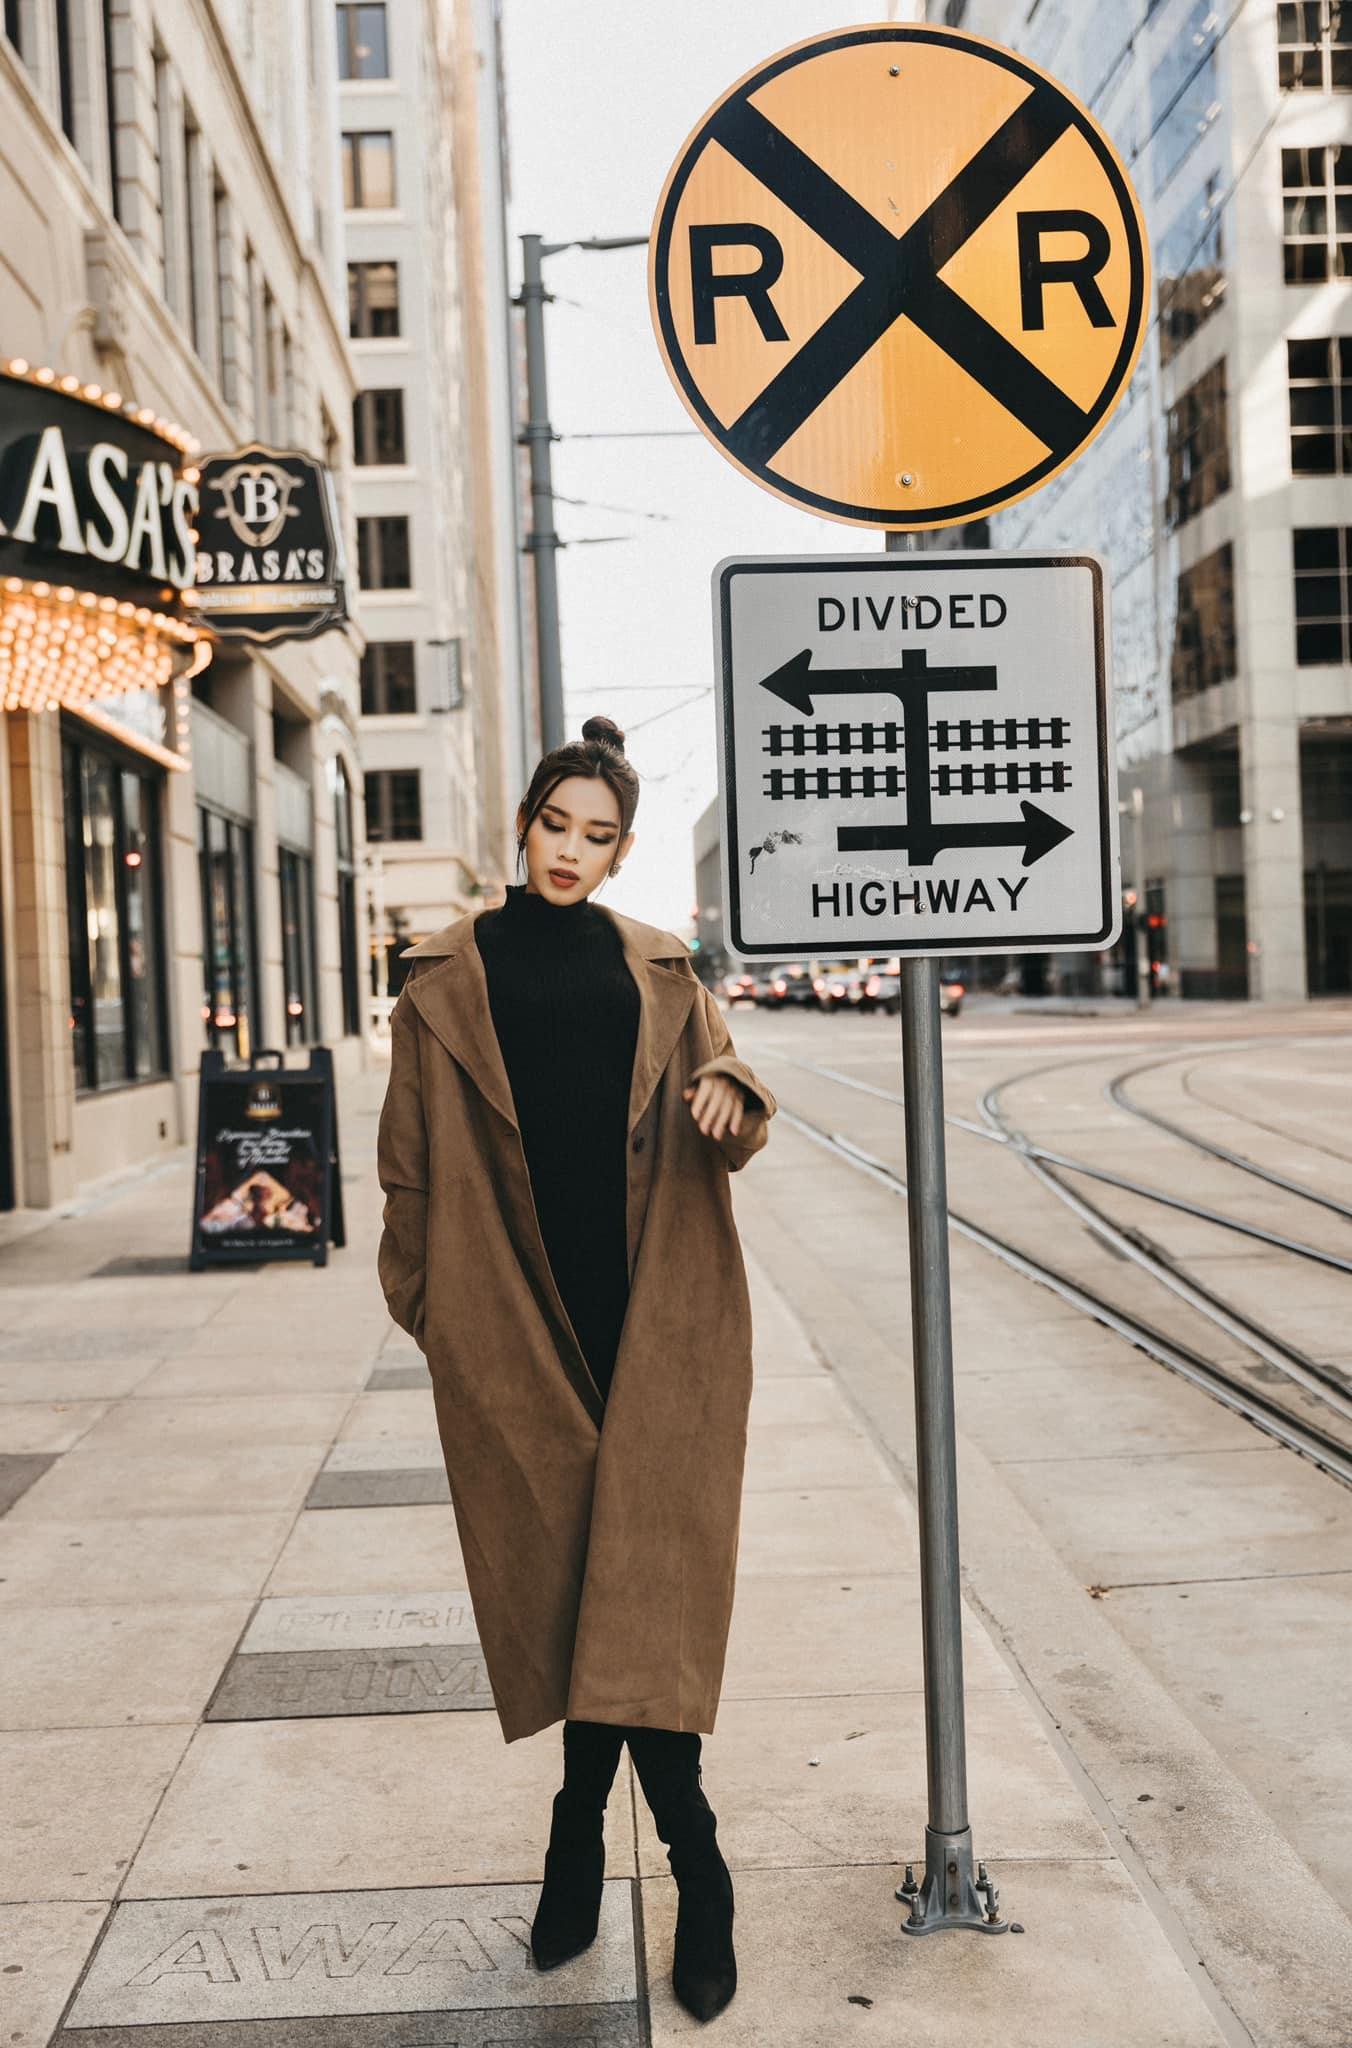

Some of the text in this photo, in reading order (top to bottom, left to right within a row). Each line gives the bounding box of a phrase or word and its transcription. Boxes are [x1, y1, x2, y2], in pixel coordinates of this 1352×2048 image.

[688, 208, 1117, 346] R R
[0, 425, 200, 590] ASA'S
[239, 476, 280, 524] B
[199, 549, 326, 583] BRASA'S
[817, 594, 1008, 632] DIVIDED
[812, 876, 1030, 918] HIGHWAY
[278, 1606, 474, 1634] PERI
[254, 1656, 490, 1704] TIM
